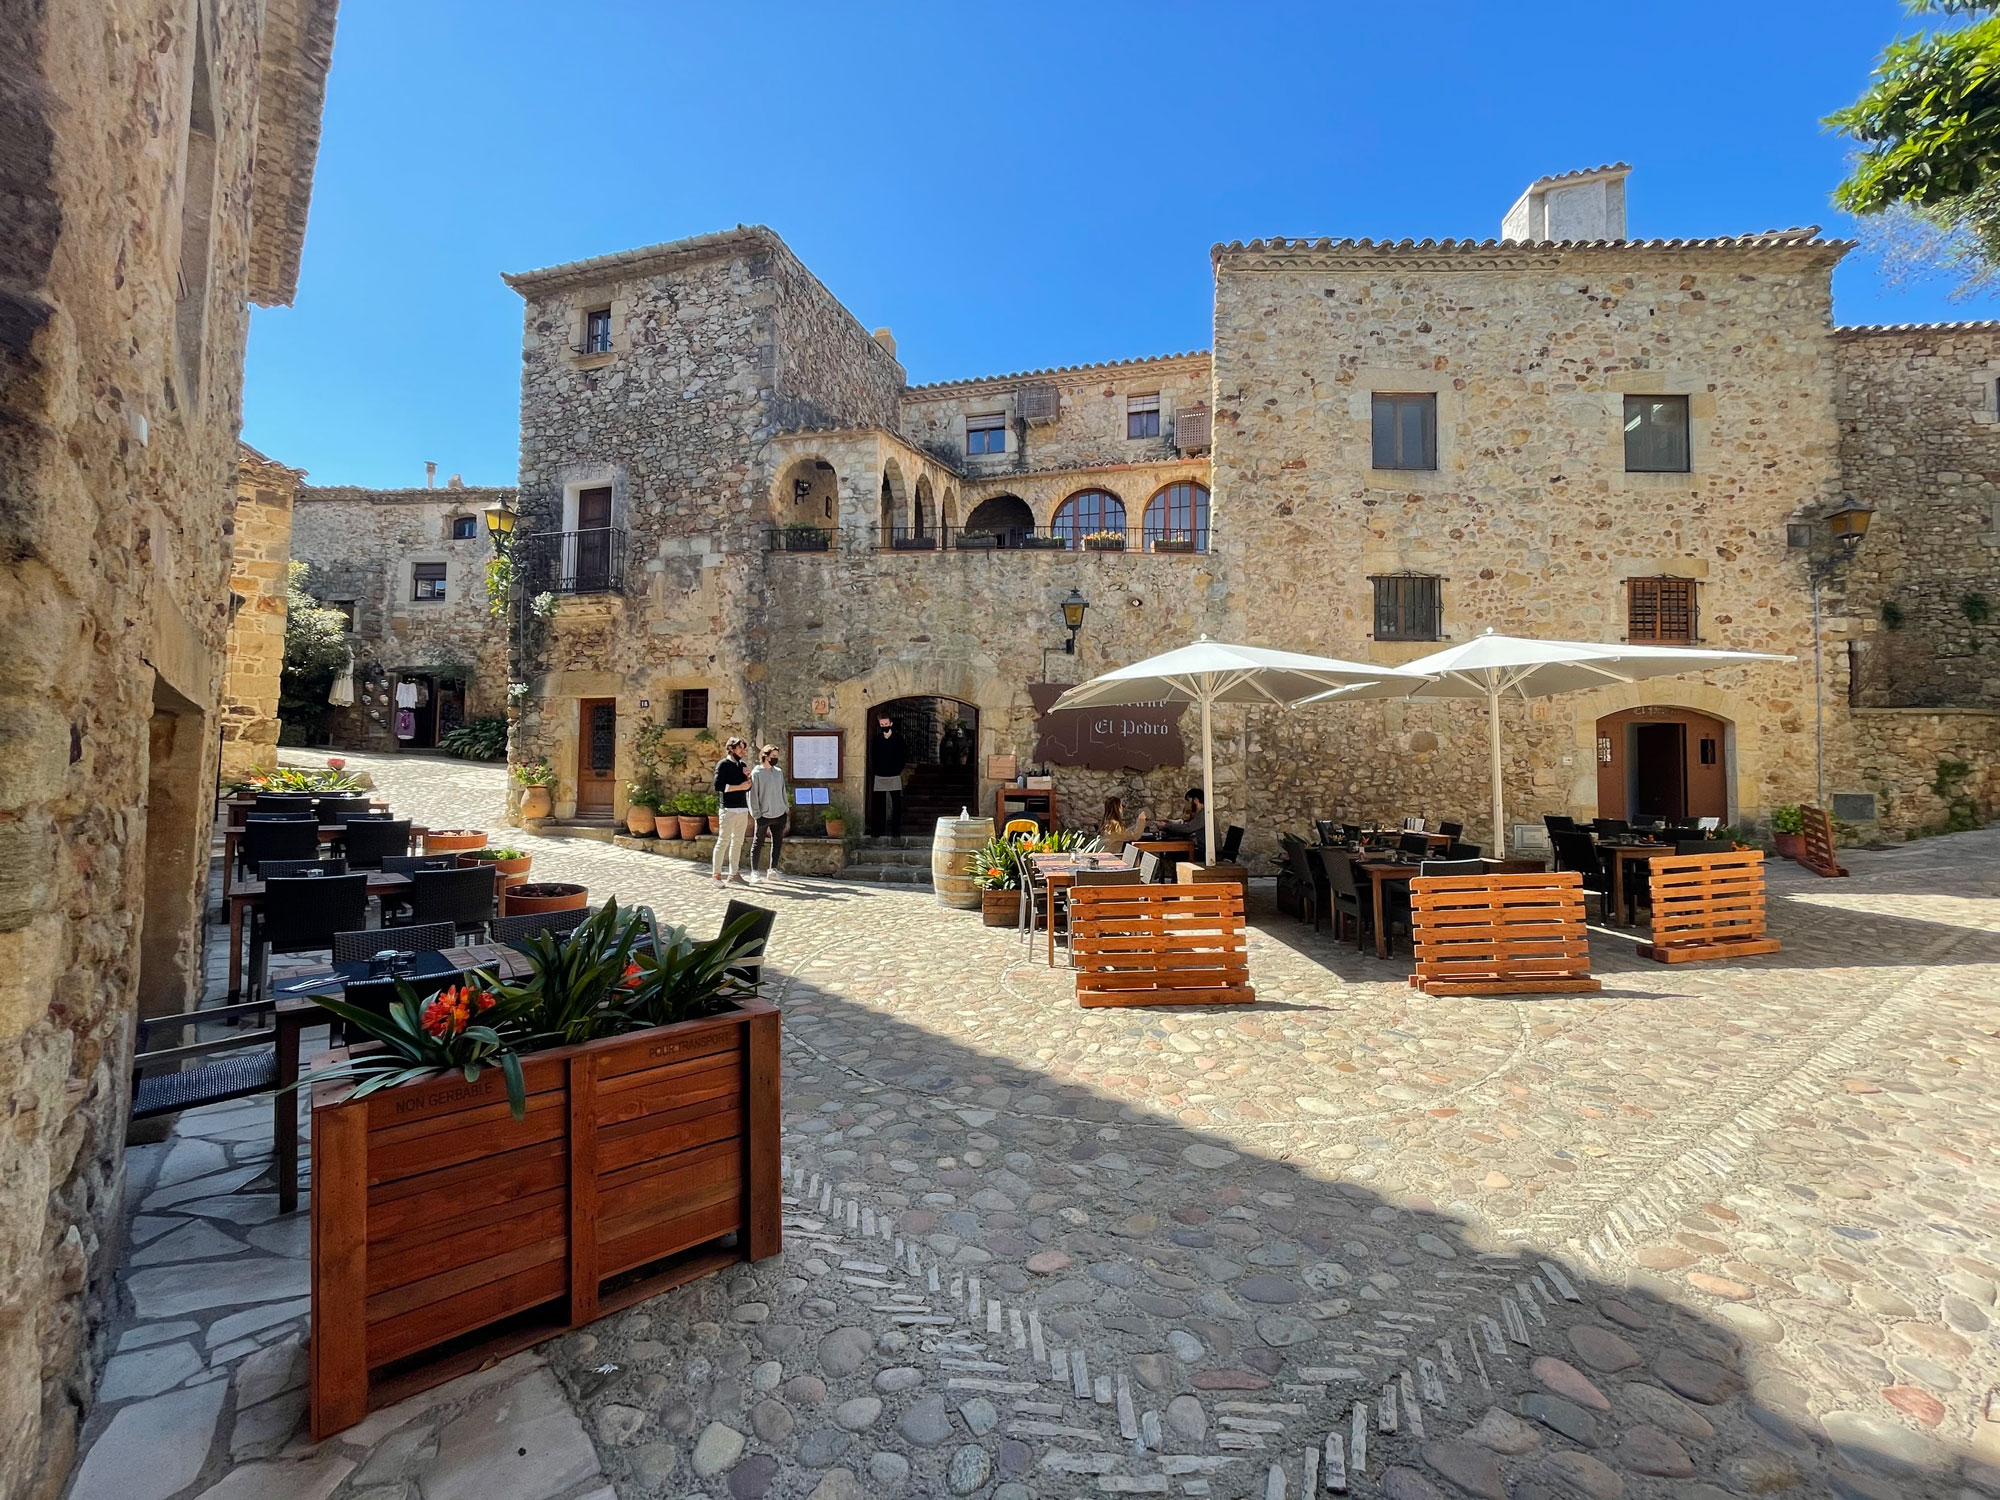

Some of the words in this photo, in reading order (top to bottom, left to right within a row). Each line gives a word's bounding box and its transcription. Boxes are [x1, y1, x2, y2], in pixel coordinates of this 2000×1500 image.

[814, 700, 826, 711] 29
[1535, 707, 1545, 717] 31
[1095, 719, 1113, 734] El
[1121, 719, 1168, 737] Pedró
[648, 1044, 676, 1058] POUR
[677, 1031, 729, 1052] TRANSPORT
[396, 1096, 425, 1113] NON
[429, 1082, 493, 1106] GERBABLE
